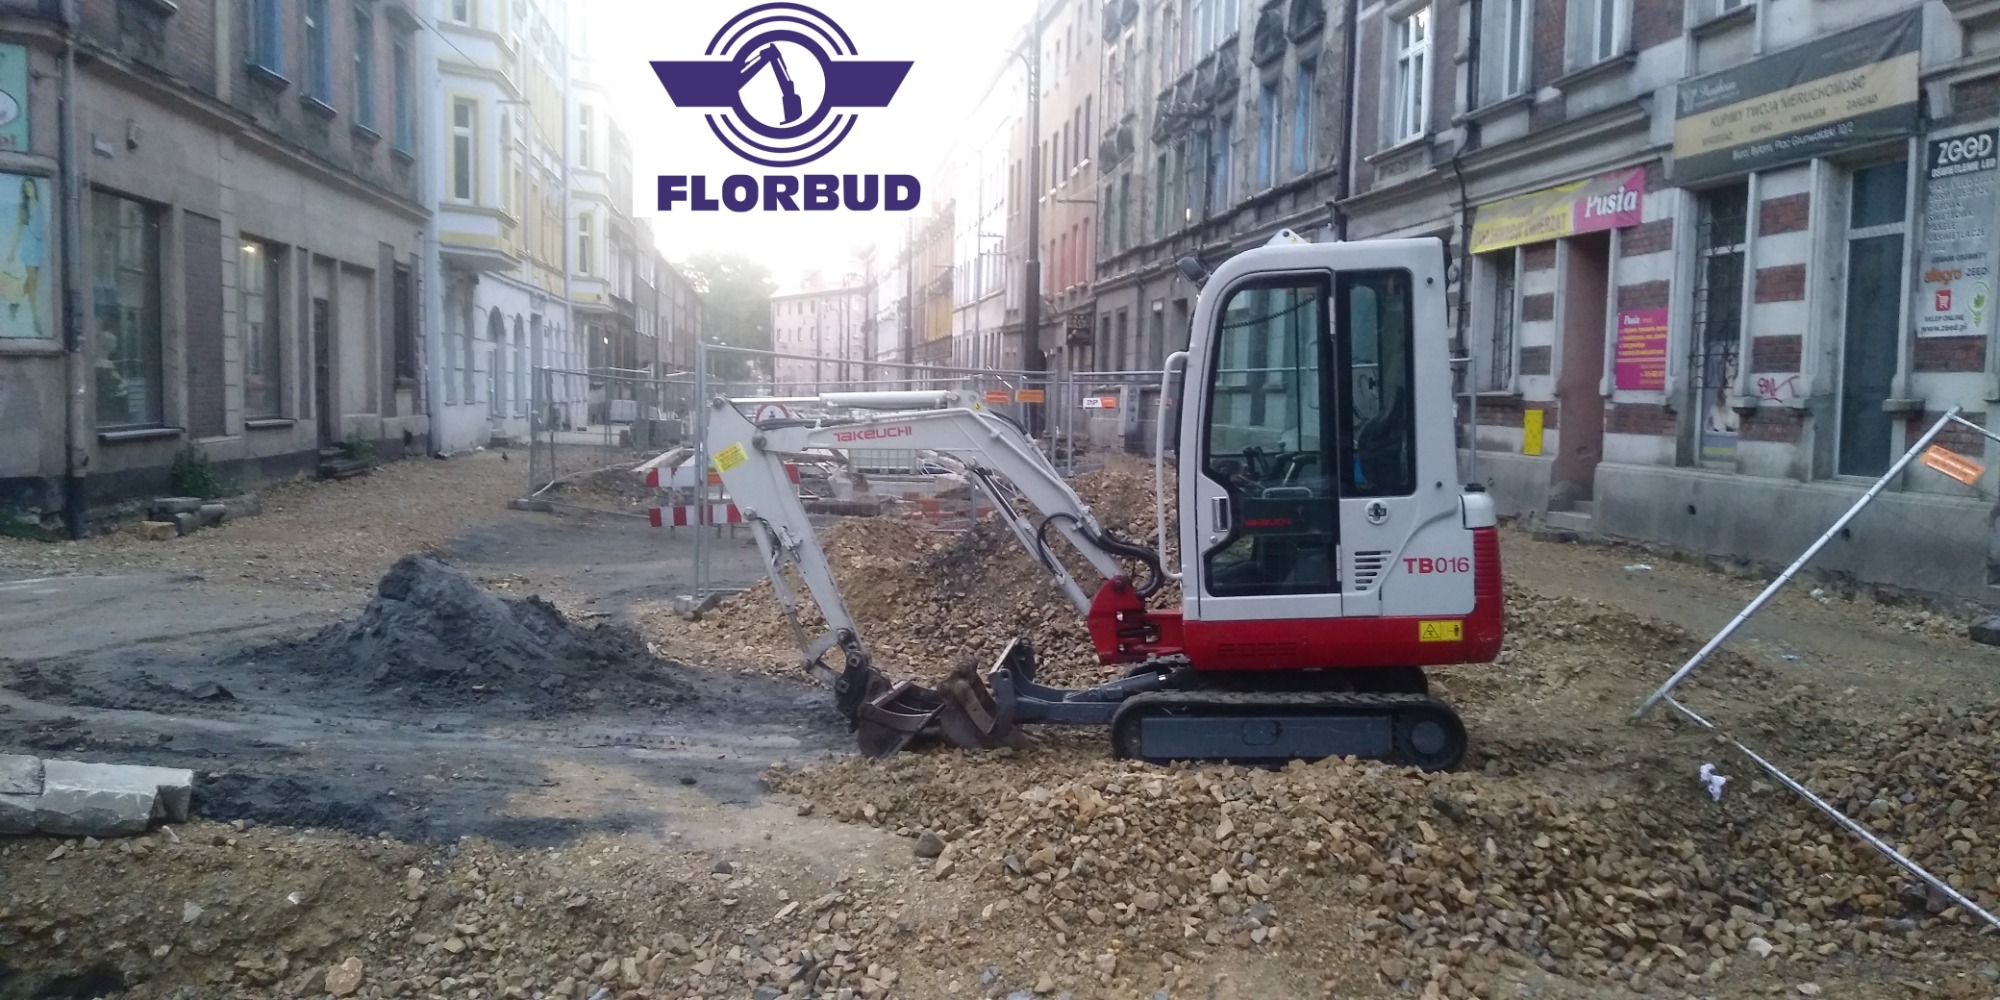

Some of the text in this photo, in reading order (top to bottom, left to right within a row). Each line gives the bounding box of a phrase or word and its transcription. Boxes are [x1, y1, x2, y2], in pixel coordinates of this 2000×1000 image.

[1980, 157, 1996, 169] LED
[1584, 186, 1638, 218] Pusia
[833, 426, 913, 443] TAKEUCHI
[1402, 556, 1470, 575] TB016
